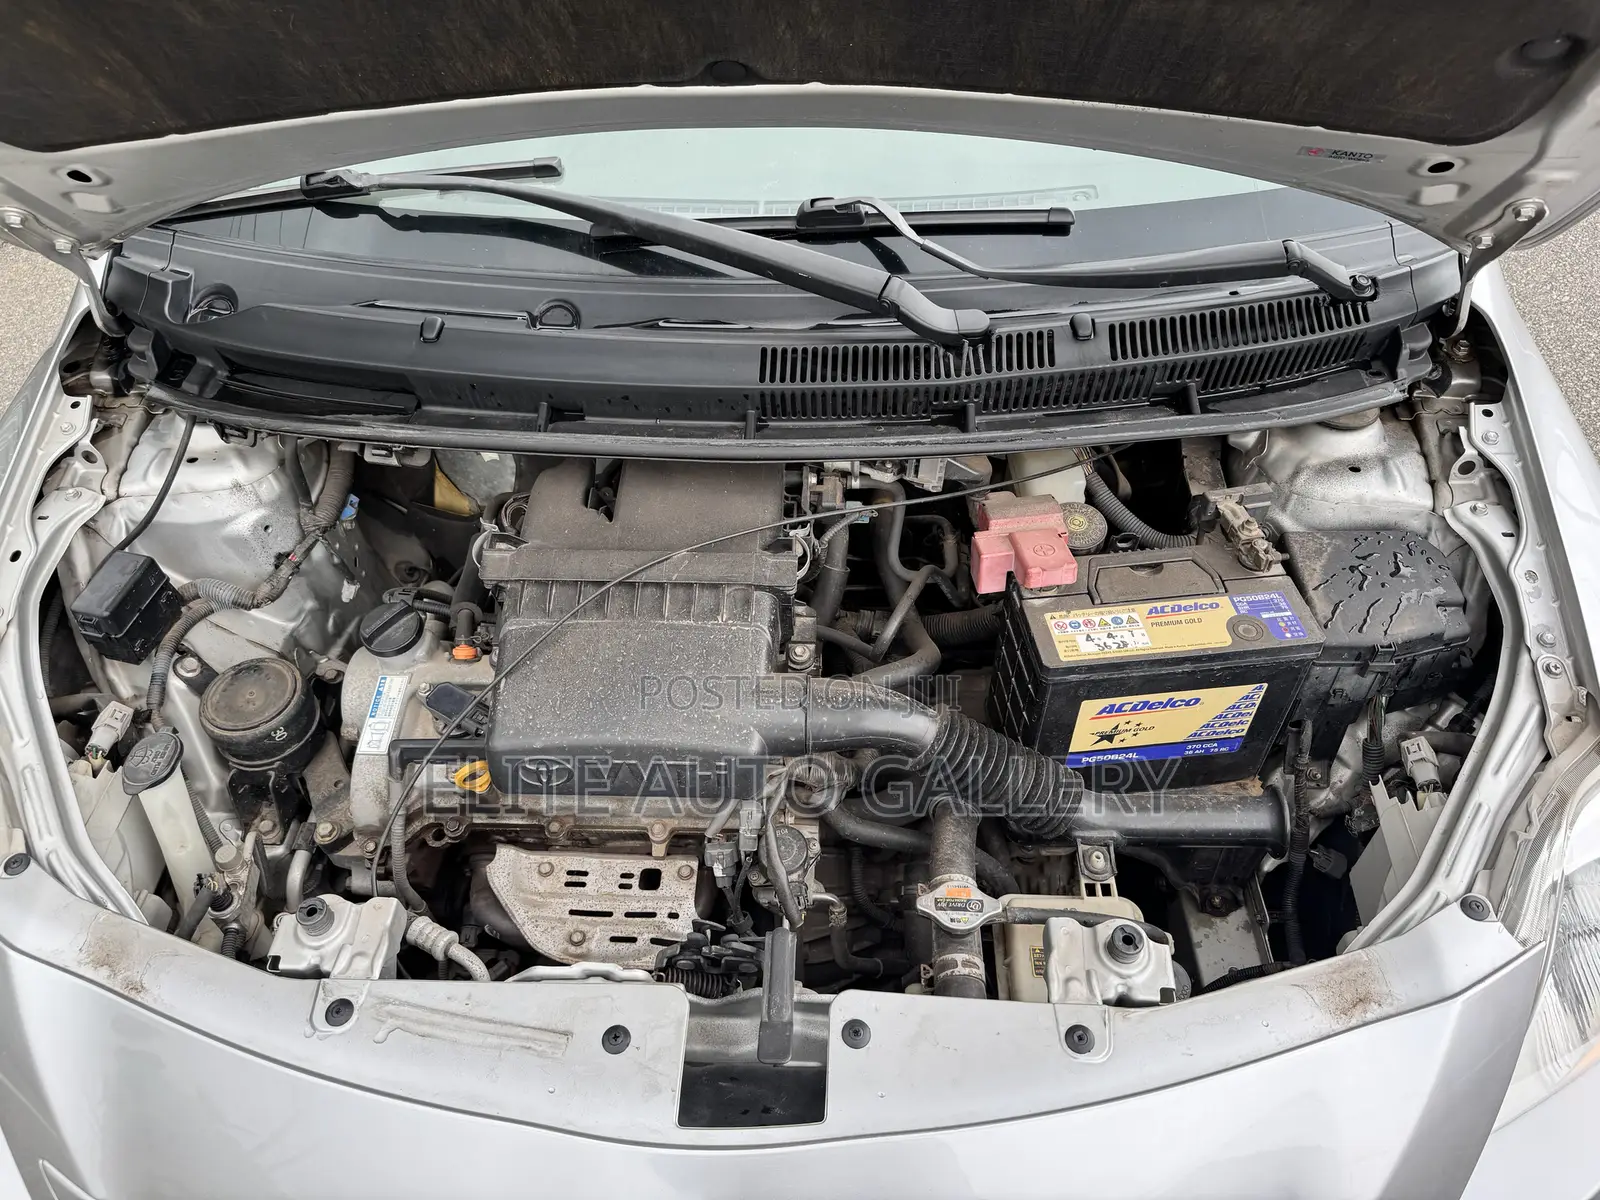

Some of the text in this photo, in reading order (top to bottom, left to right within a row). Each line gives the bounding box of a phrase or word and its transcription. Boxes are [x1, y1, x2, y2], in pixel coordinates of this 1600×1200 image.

[1331, 149, 1373, 158] KANTO
[1147, 602, 1220, 616] ACDelco
[1151, 616, 1203, 628] PREMIUM GOLD
[1251, 684, 1264, 692] A
[1238, 693, 1261, 701] AC
[1095, 697, 1202, 716] ACDelco
[1094, 728, 1132, 736] PREMIUM
[1186, 728, 1246, 739] ACDelco
[1081, 753, 1139, 763] PG50B24L
